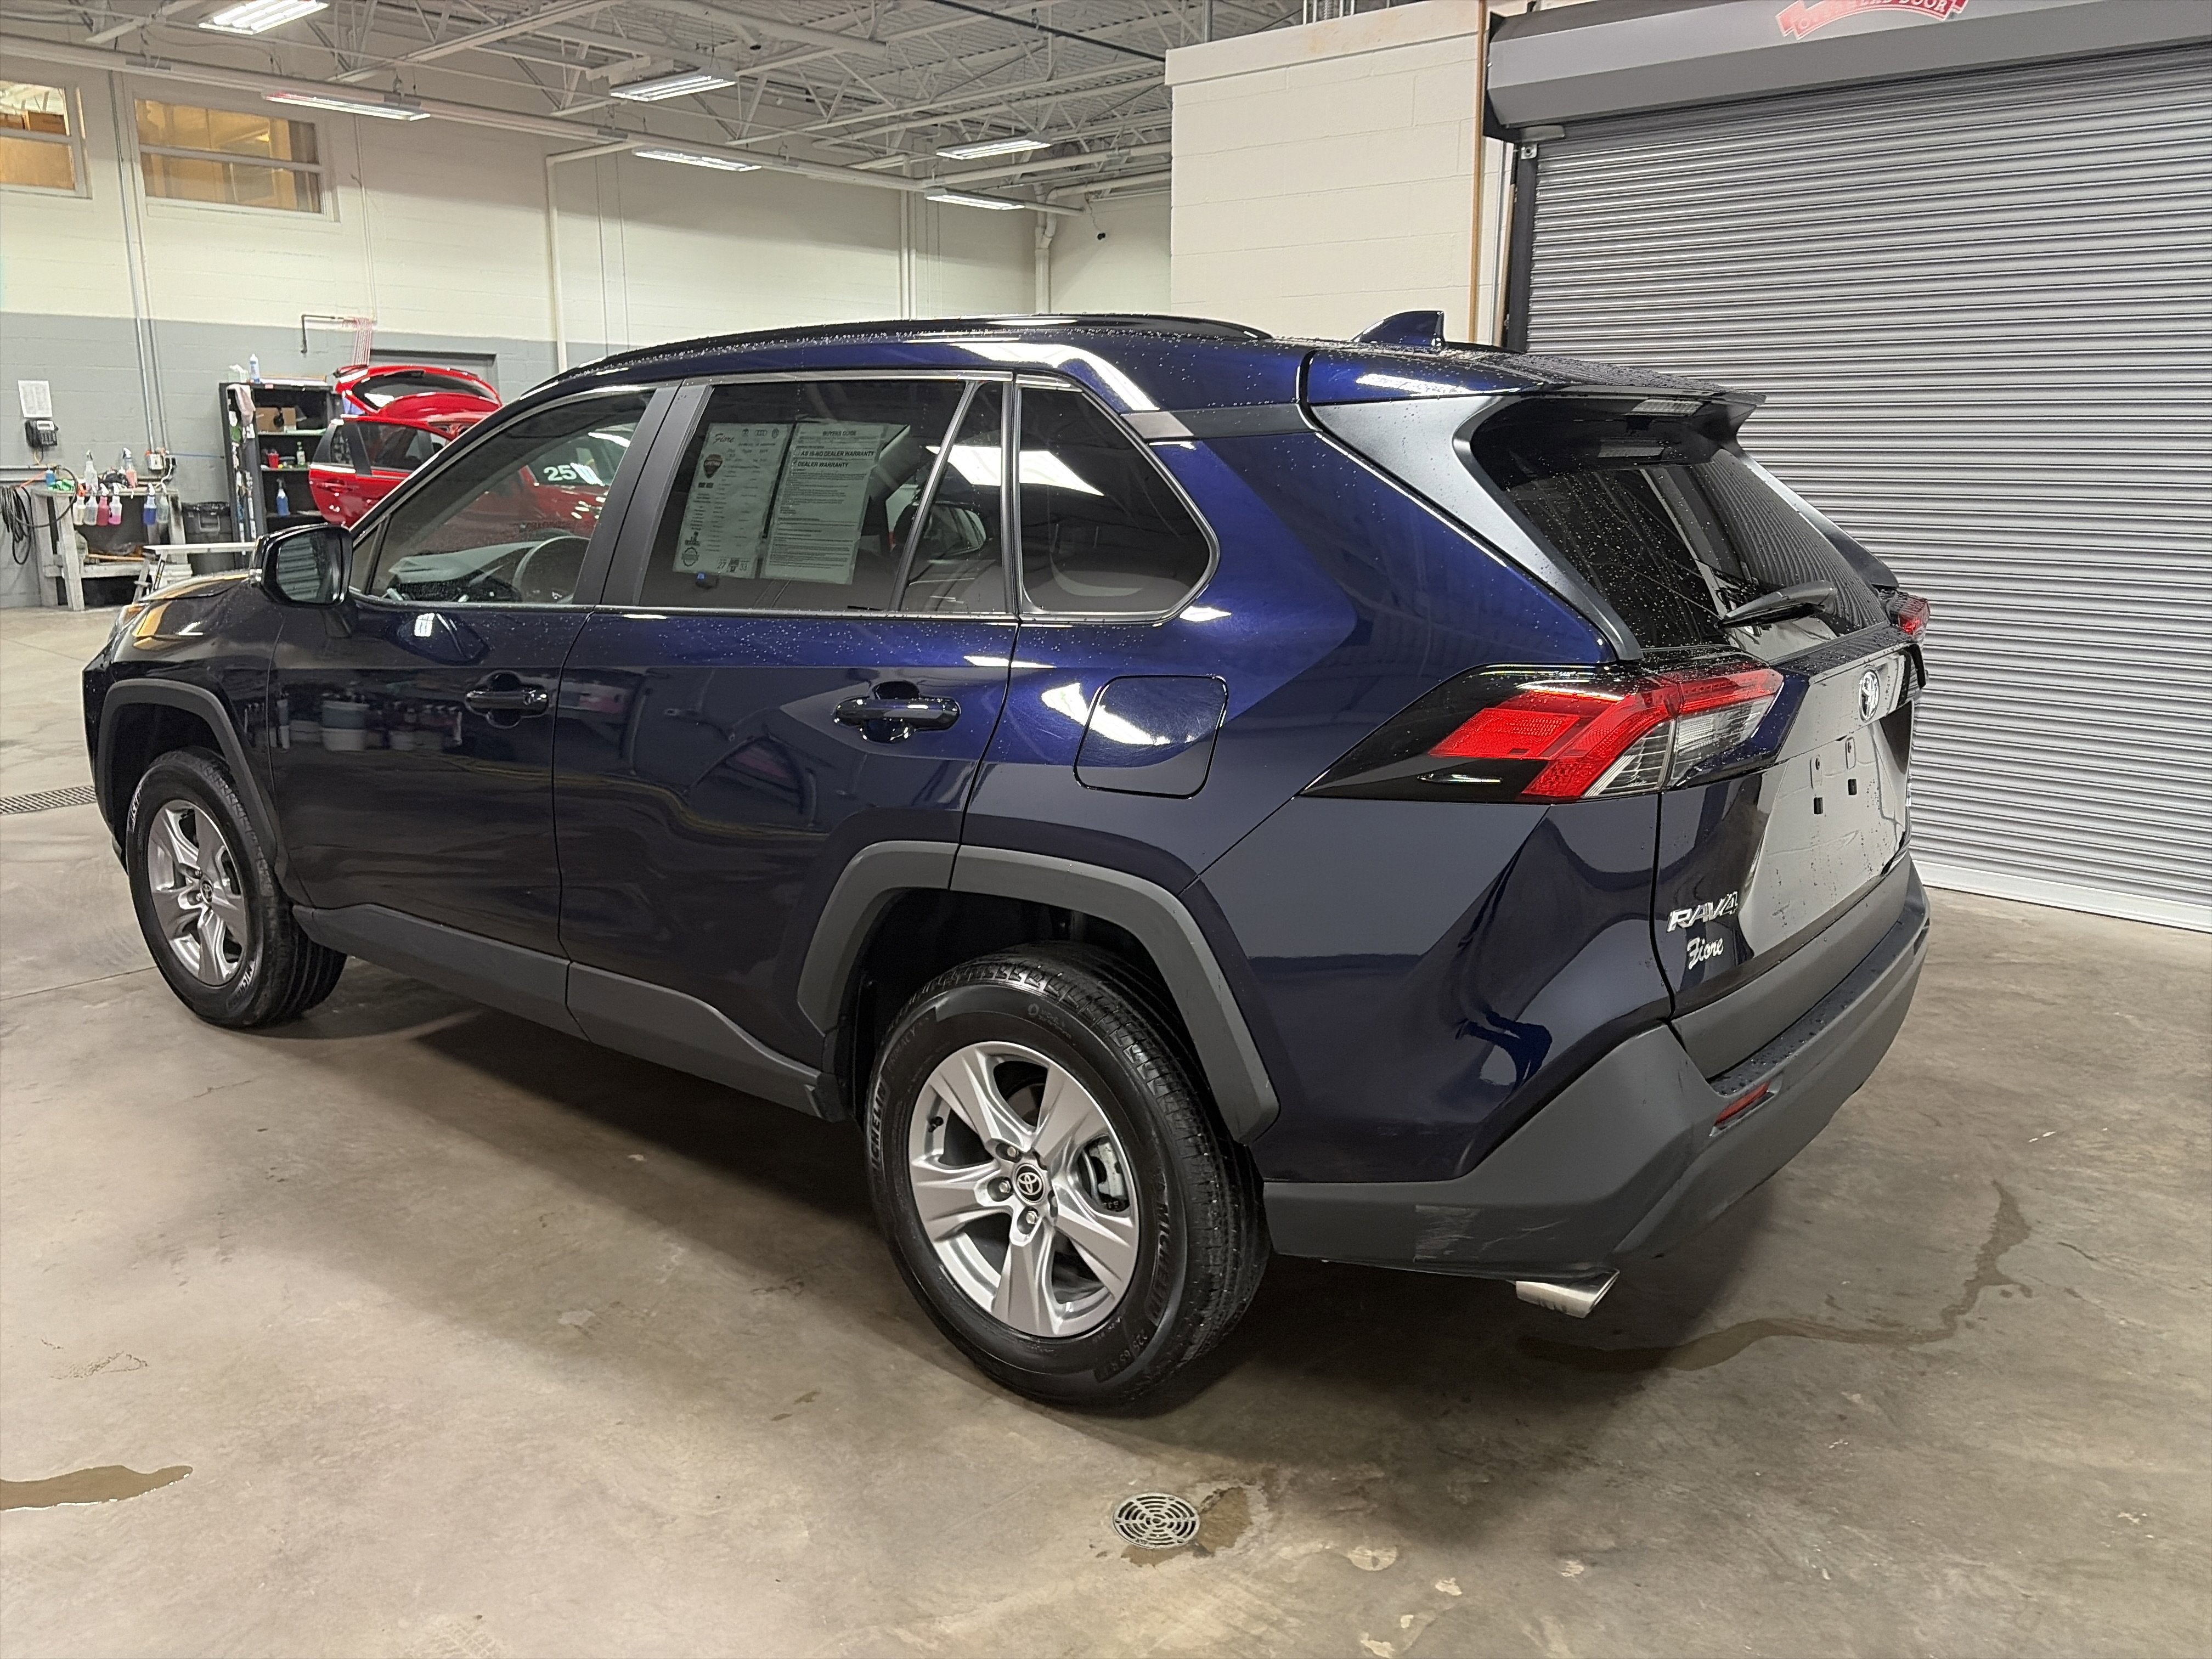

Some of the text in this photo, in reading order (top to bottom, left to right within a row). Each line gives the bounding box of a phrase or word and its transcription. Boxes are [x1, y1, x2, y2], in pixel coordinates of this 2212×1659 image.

[713, 432, 735, 444] Fiore
[543, 465, 577, 481] 25
[1666, 891, 1739, 933] RAV4
[1686, 936, 1724, 970] Fiore
[870, 1081, 887, 1173] ICHELIN
[1147, 1201, 1171, 1321] MICHELIN
